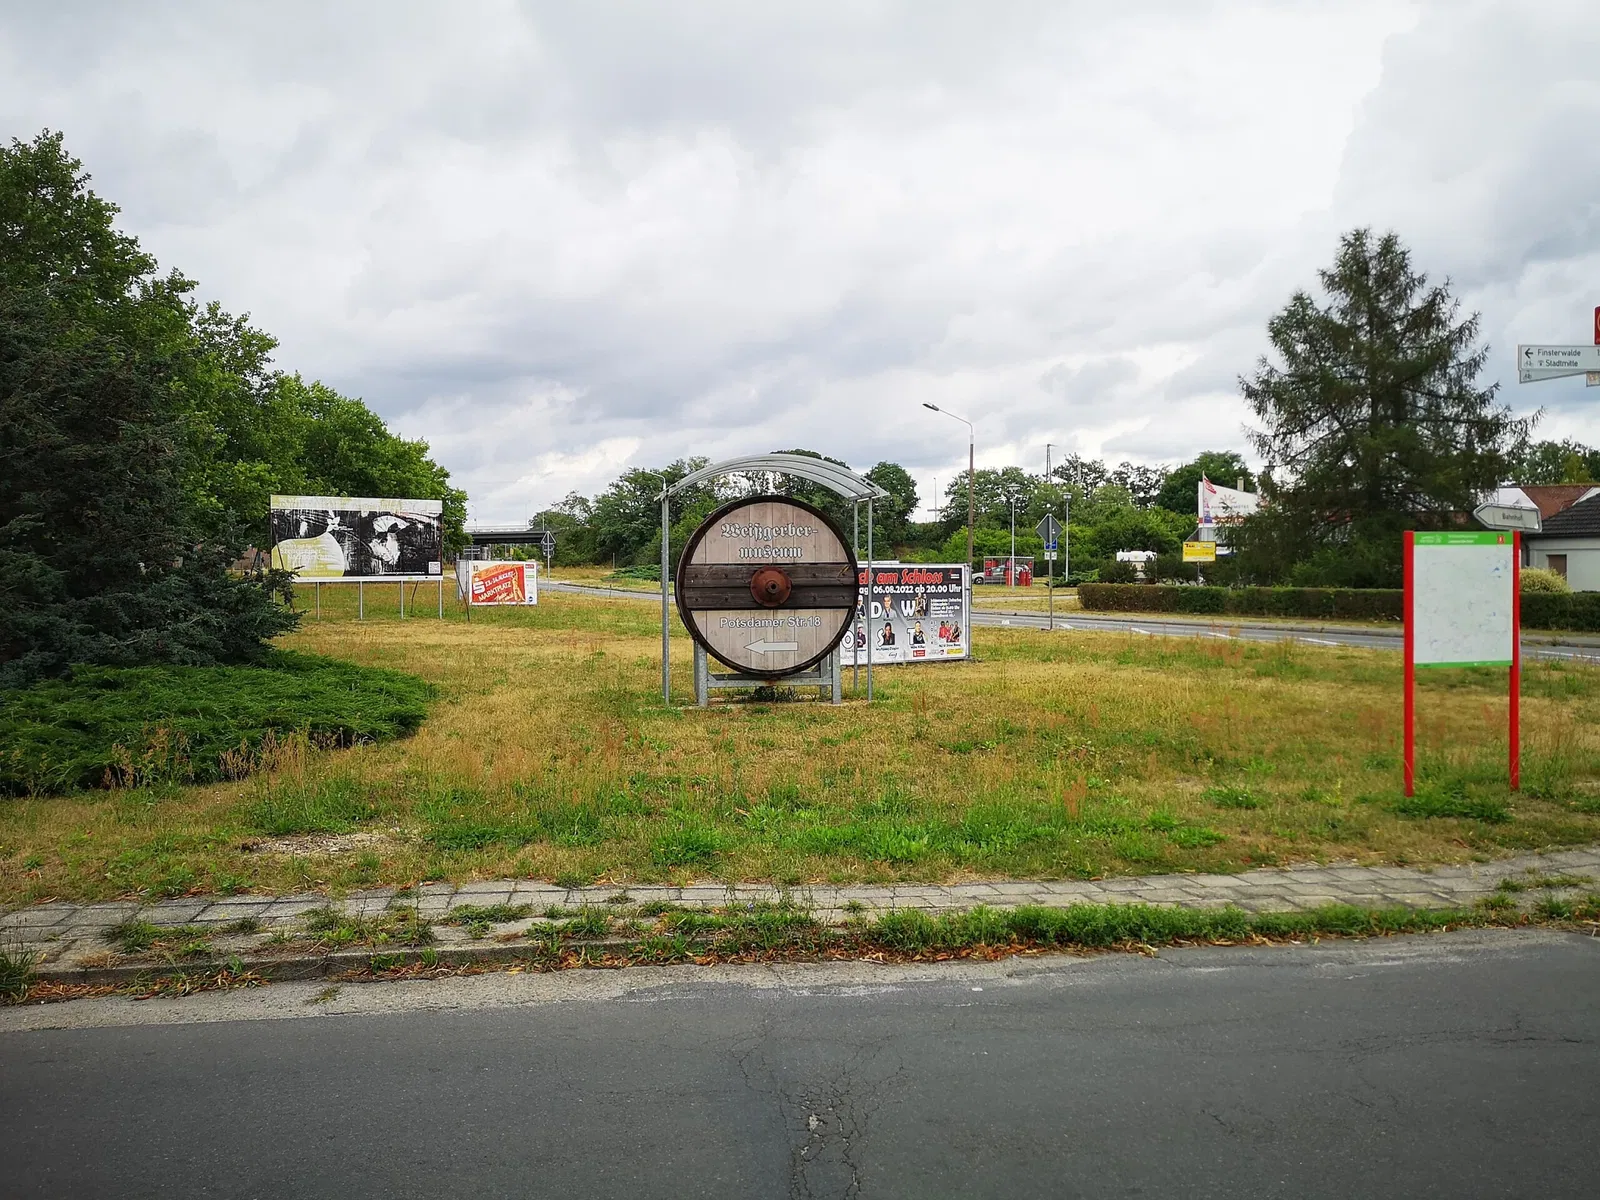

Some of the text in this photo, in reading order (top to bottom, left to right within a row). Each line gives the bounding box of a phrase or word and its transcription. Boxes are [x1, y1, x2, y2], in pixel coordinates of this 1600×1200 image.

[1537, 348, 1581, 357] Finsterwalde
[1545, 359, 1579, 368] Stadtmitte
[738, 544, 803, 559] museum
[876, 572, 898, 585] am
[901, 568, 943, 585] Schloss
[873, 585, 914, 594] 06.08.2022
[914, 584, 925, 594] ab
[926, 585, 948, 593] 20.00
[948, 584, 961, 592] Uhr
[719, 616, 785, 628] Potsdamer
